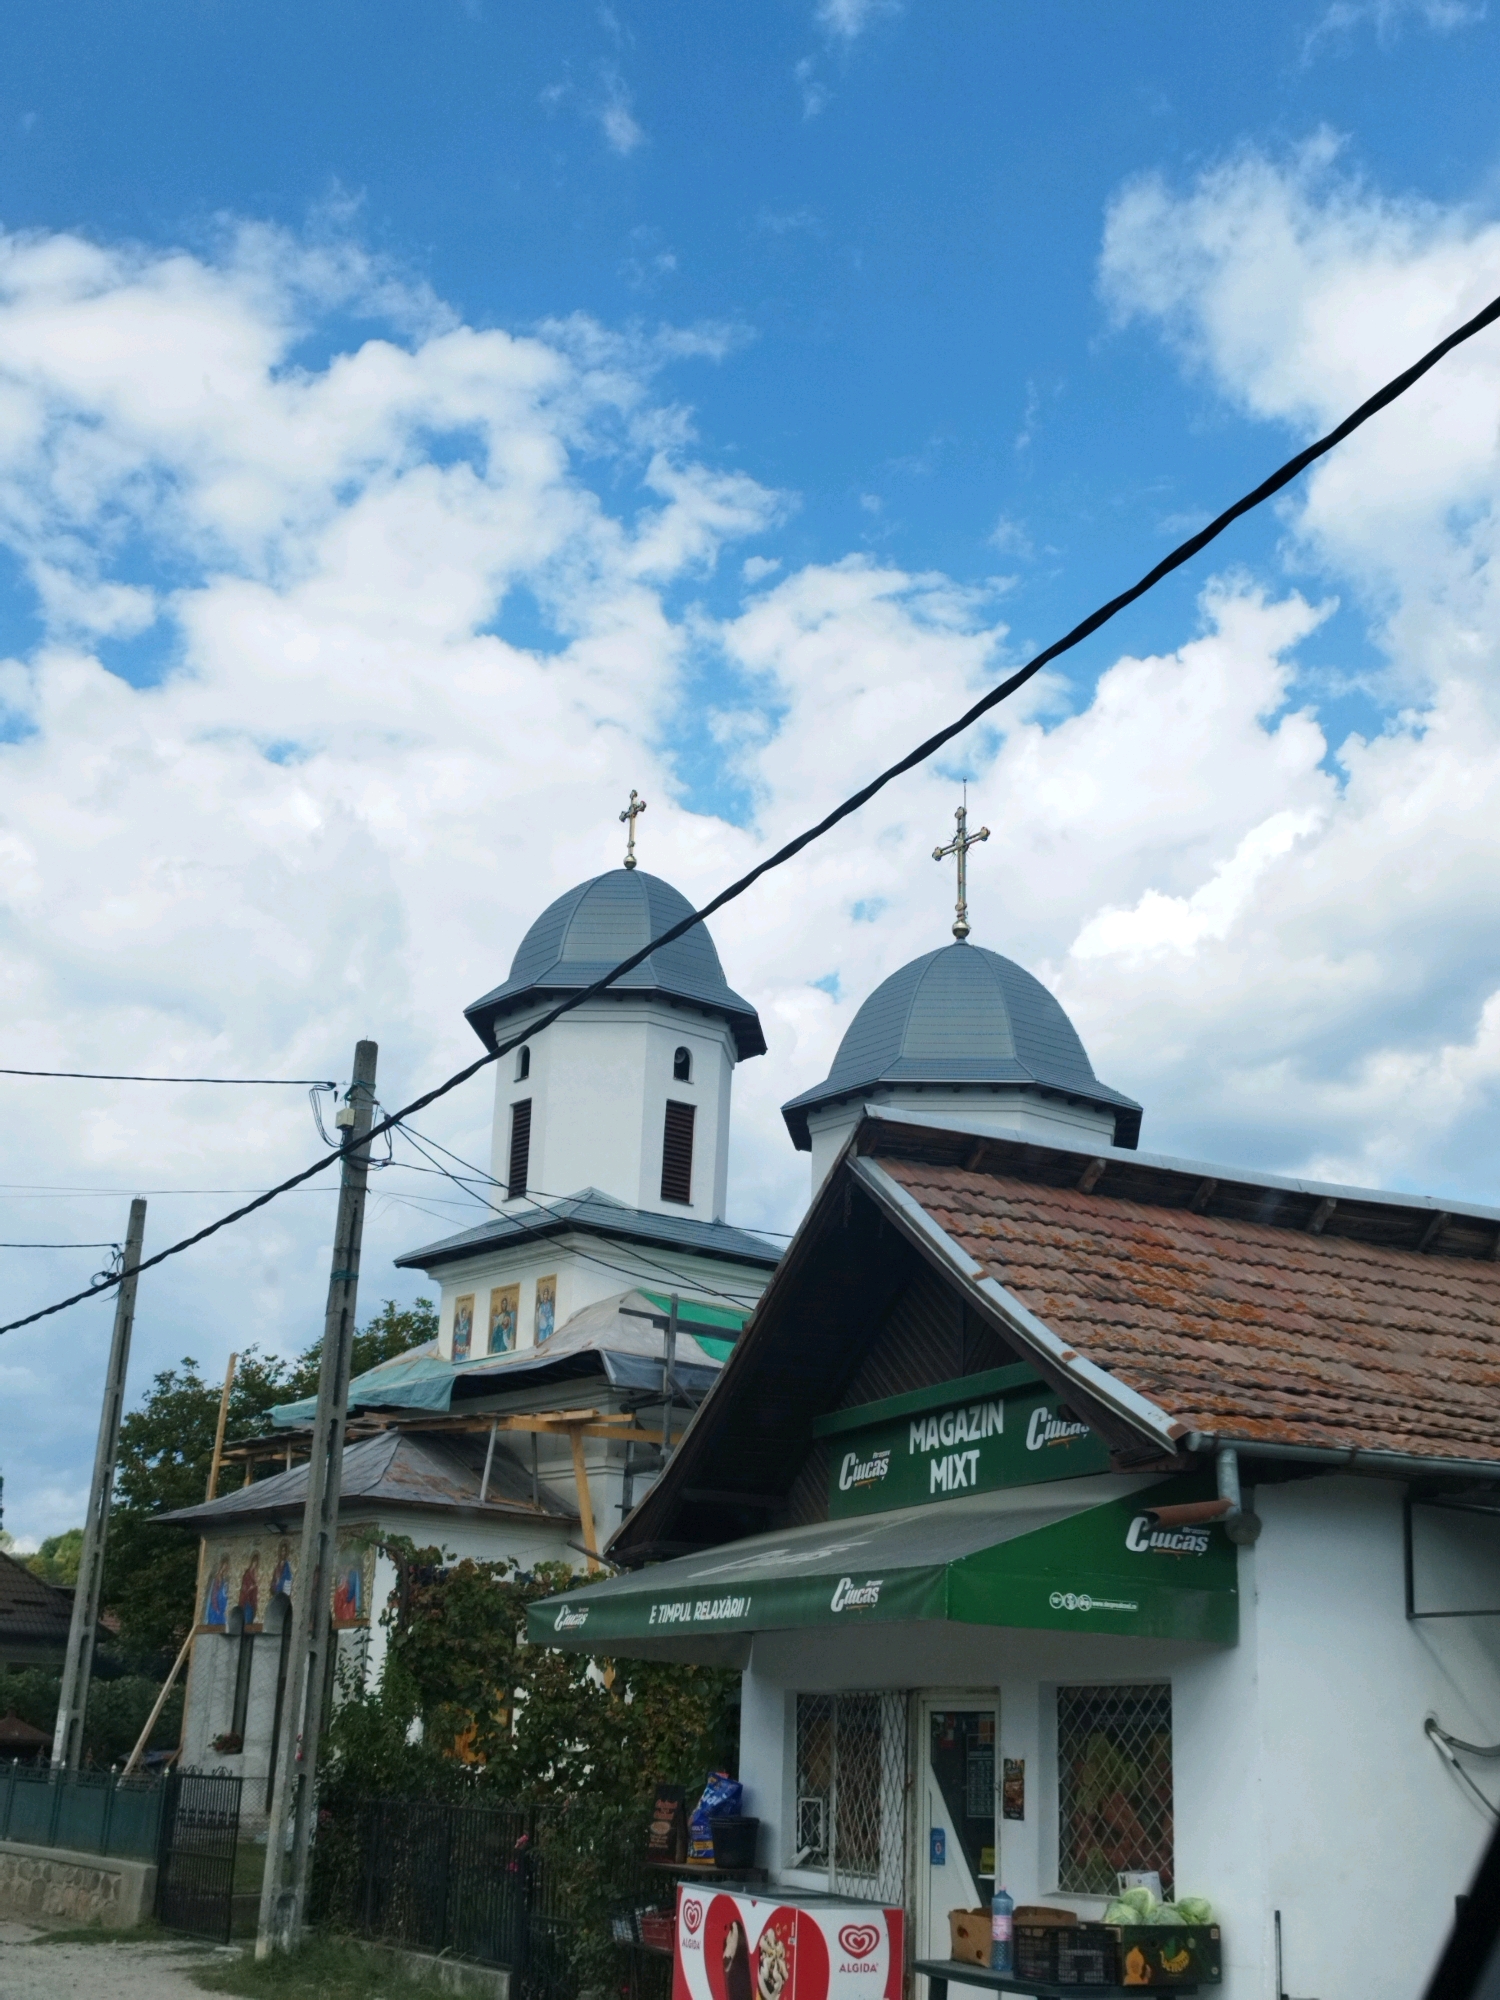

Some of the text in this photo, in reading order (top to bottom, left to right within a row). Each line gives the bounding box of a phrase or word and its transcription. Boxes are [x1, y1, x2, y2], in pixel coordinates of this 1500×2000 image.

[909, 1399, 1004, 1455] MAGAZIN
[839, 1452, 889, 1491] Ciucaș
[930, 1449, 980, 1493] MIXT
[649, 1605, 657, 1624] E
[658, 1602, 692, 1623] TIMPUL
[830, 1577, 880, 1613] Ciucaș
[682, 1938, 701, 1950] ALGIDA
[839, 1962, 877, 1973] ALGIDA
